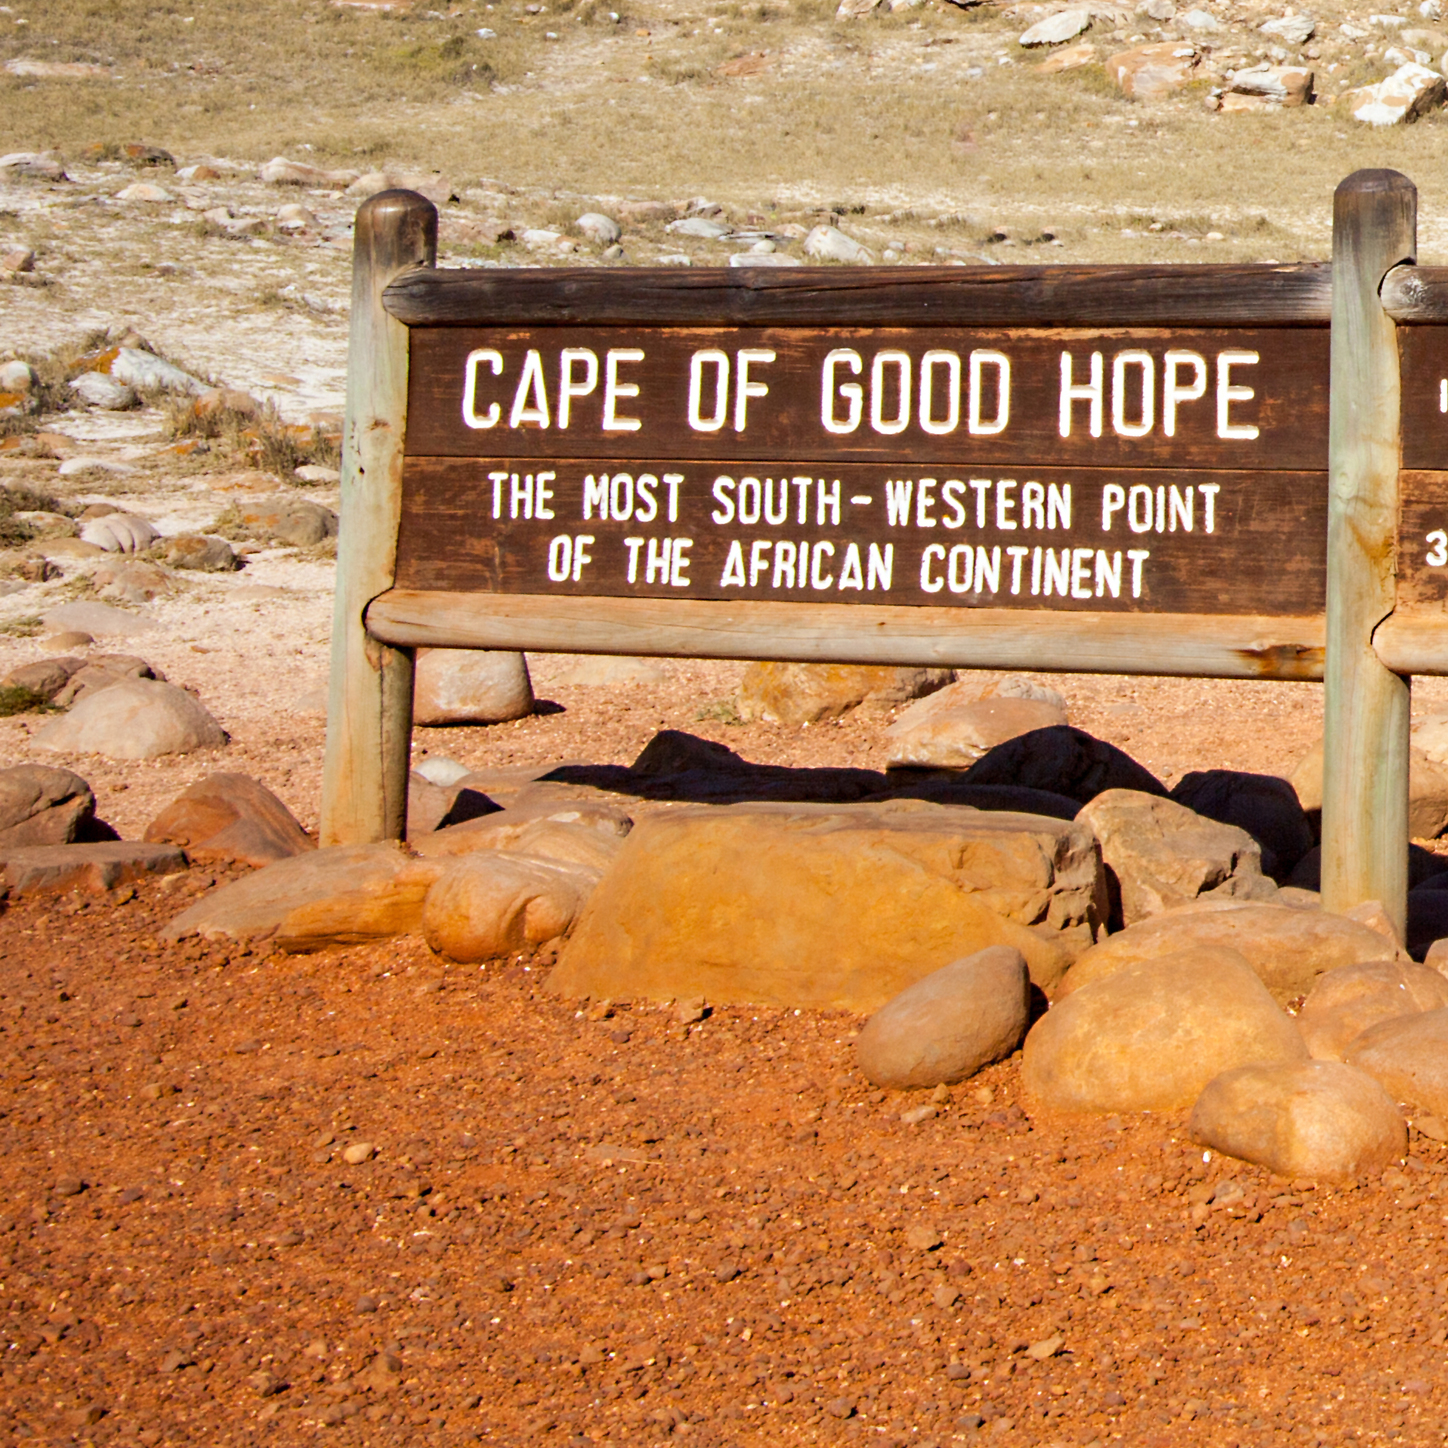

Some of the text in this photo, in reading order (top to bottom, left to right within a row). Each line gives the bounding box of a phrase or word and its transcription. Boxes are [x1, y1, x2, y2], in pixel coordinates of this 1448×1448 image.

[462, 347, 1260, 440] CAPE OF GOOD HOPE
[488, 471, 556, 520] THE
[583, 472, 684, 523] MOST
[1101, 483, 1221, 534] POINT
[547, 534, 1150, 599] OF THE AFRICAN CONTINENT
